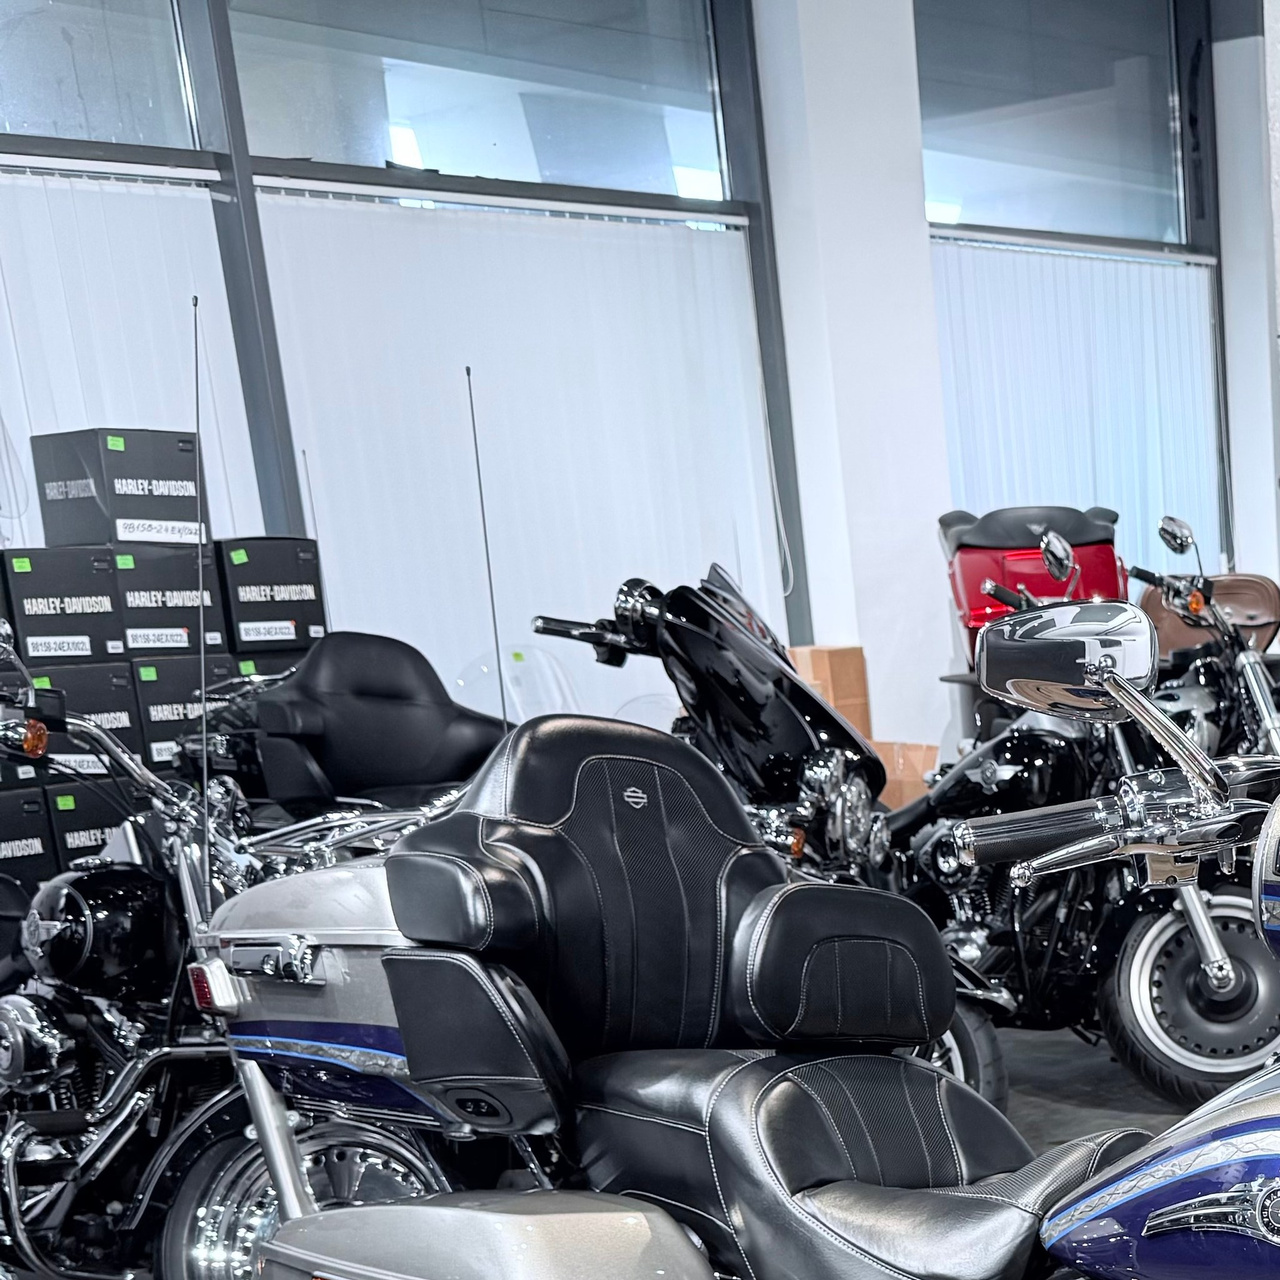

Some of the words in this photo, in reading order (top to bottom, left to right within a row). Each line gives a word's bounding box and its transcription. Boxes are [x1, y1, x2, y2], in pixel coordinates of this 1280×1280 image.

[114, 478, 197, 497] HARLEY-DAVIDSON
[126, 590, 213, 608] HARLEY-DAVIDSON
[238, 584, 316, 603] HARLEY-DAVIDSON
[23, 596, 114, 615] HARLEY-DAVIDSON
